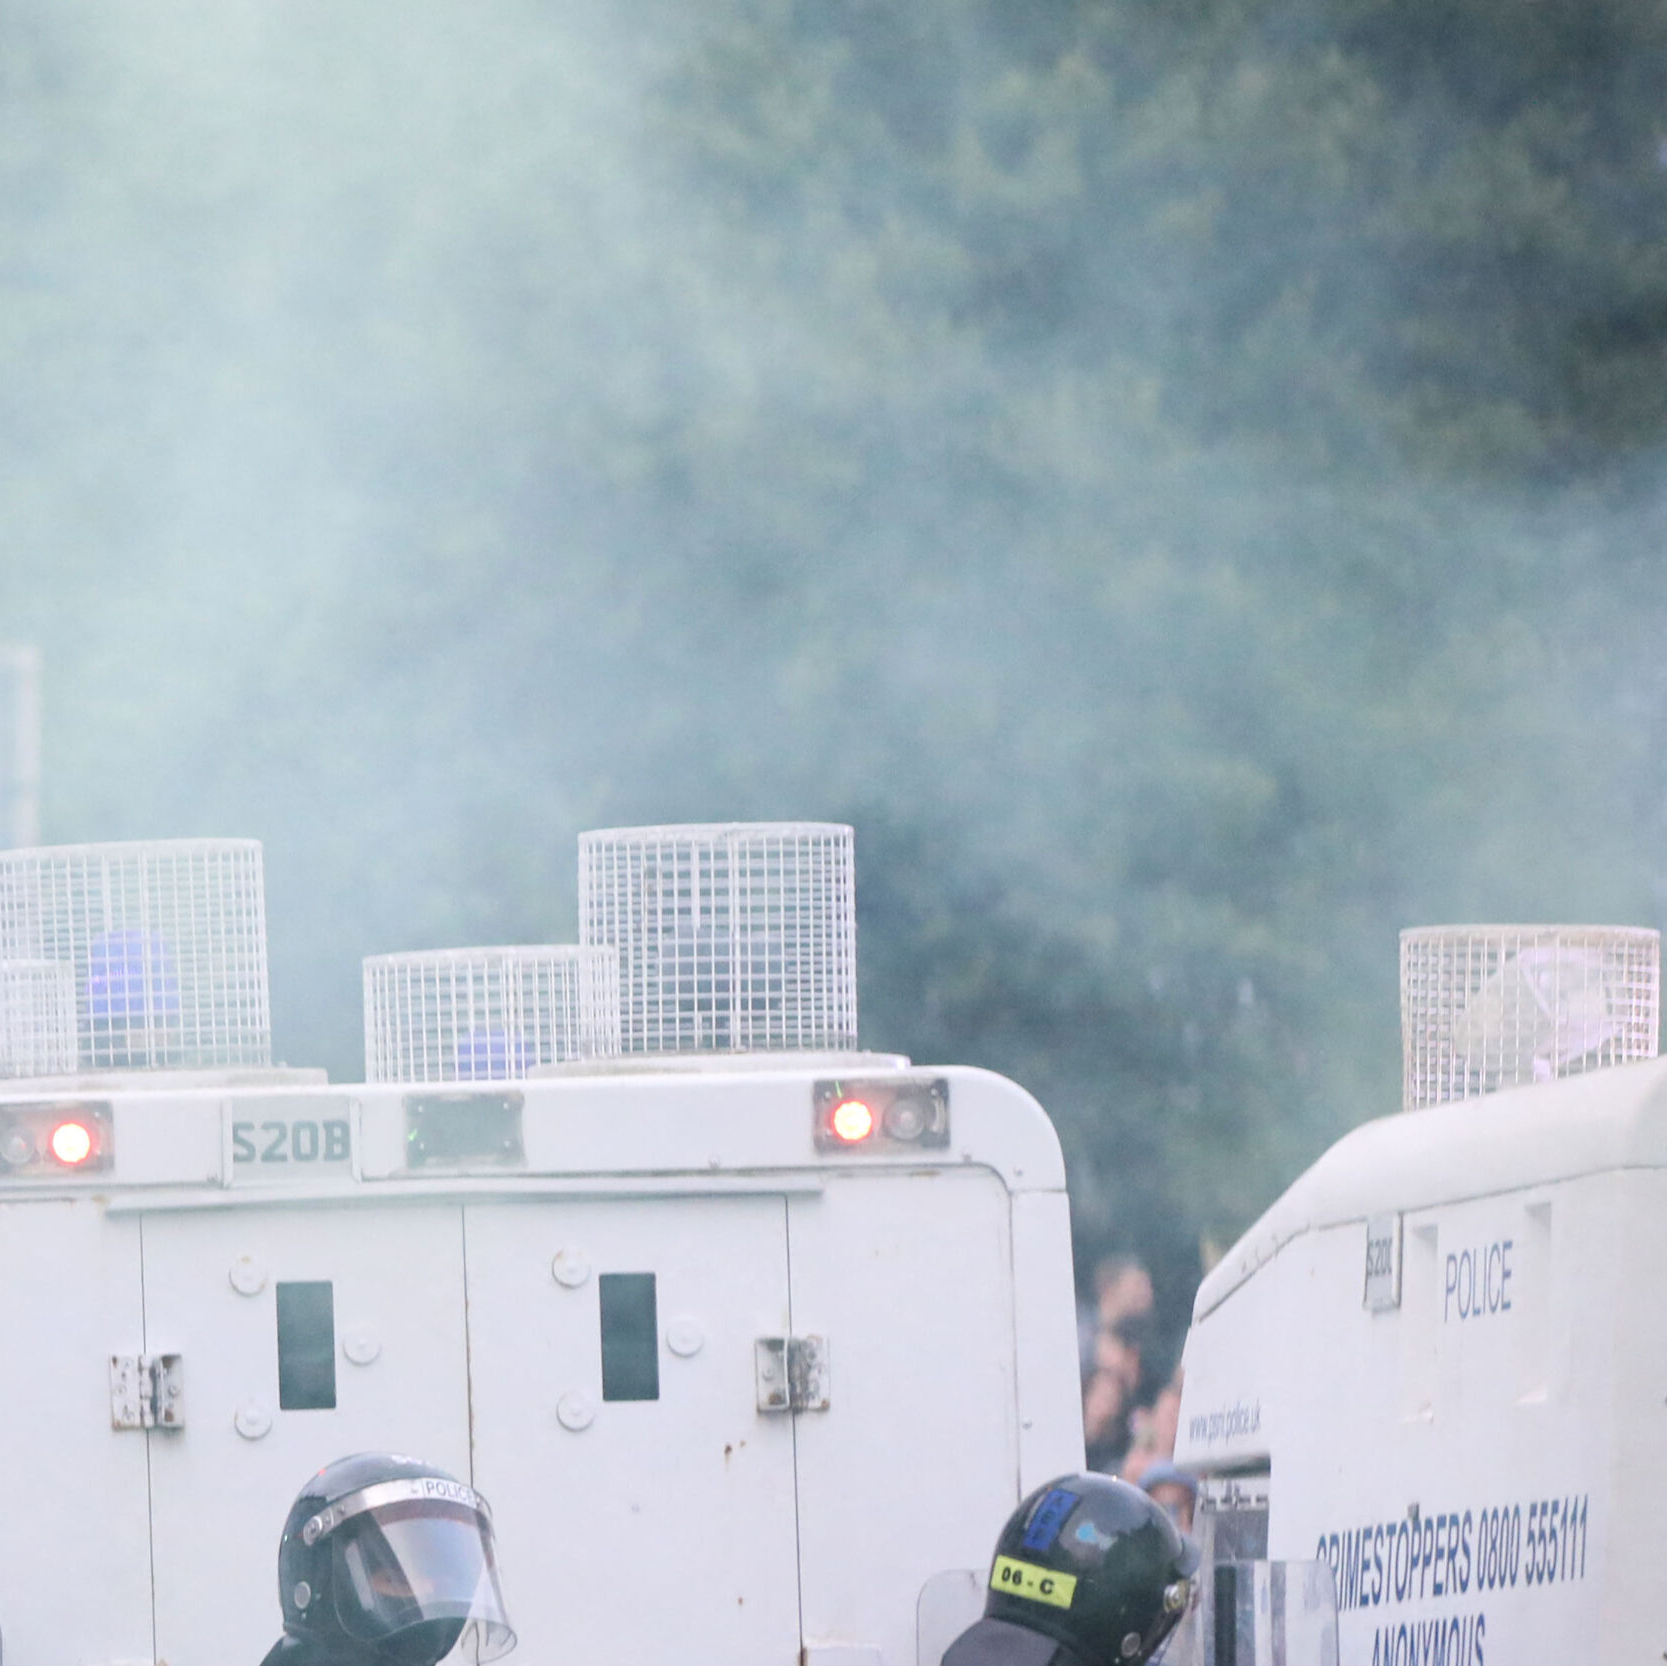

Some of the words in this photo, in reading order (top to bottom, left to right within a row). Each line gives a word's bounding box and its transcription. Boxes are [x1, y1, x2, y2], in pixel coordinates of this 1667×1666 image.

[232, 1119, 352, 1163] S20B
[1443, 1240, 1515, 1323] POLICE
[1476, 1502, 1523, 1593] 0800
[1525, 1494, 1590, 1588] 555111
